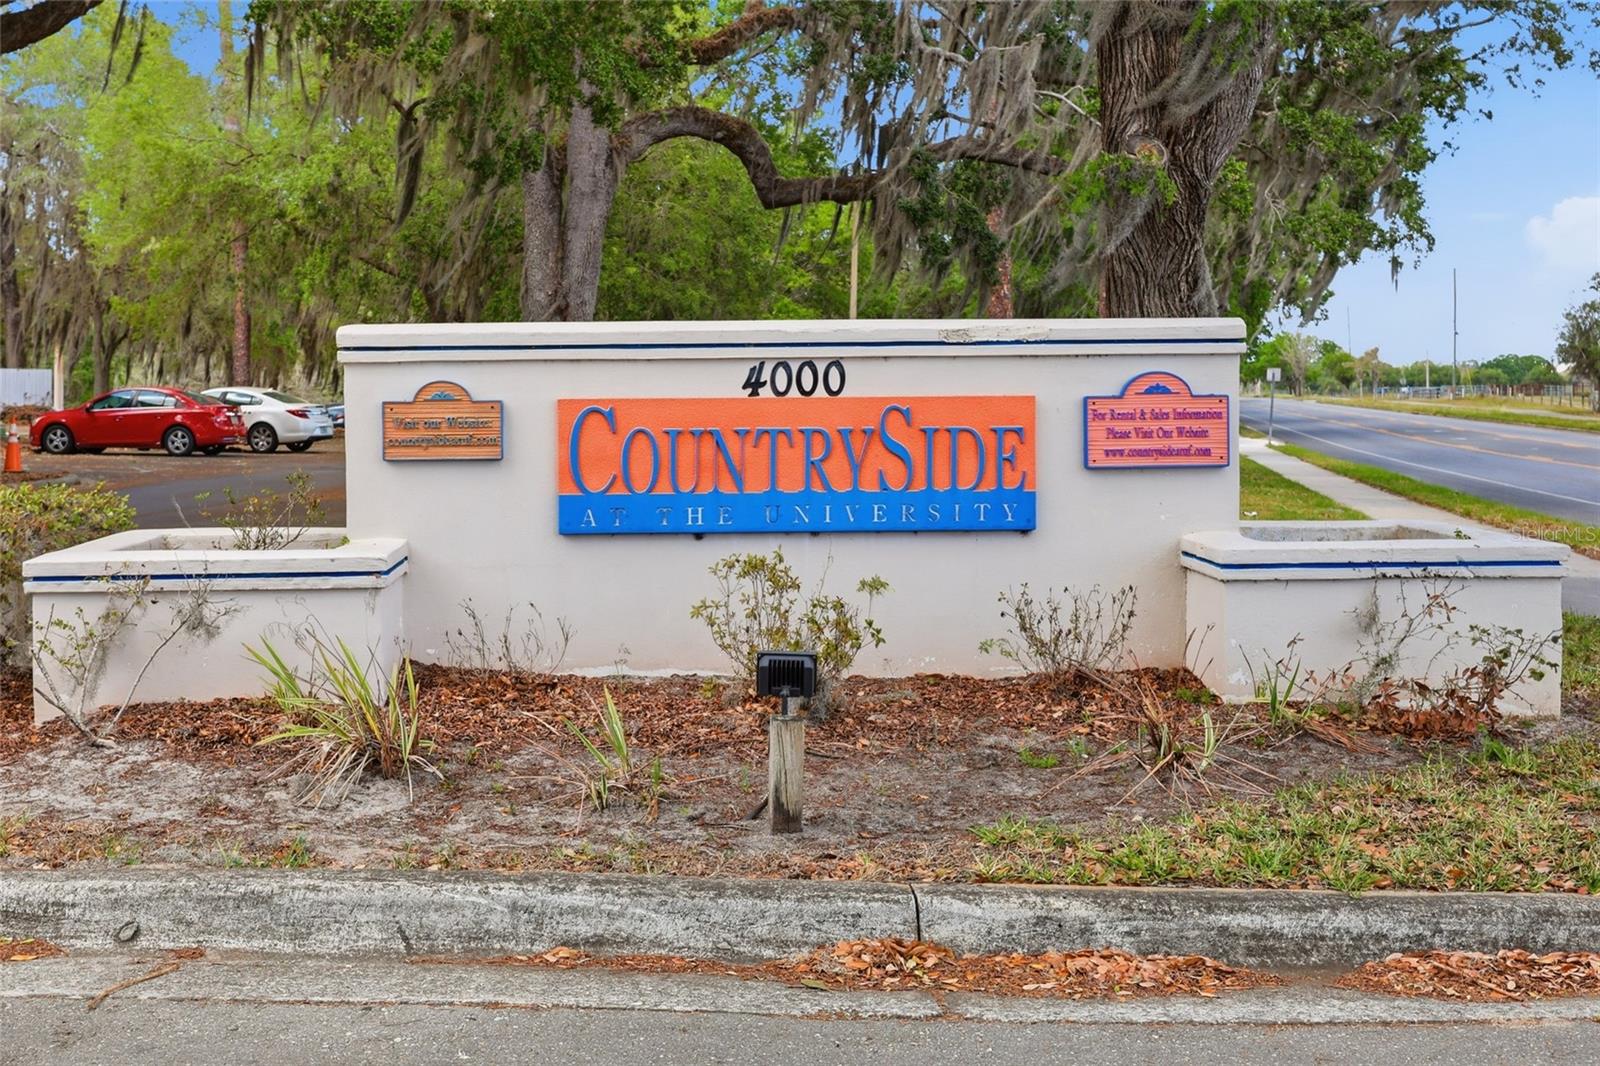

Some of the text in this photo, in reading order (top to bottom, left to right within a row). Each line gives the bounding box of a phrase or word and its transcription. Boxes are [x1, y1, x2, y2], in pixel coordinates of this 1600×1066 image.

[741, 360, 846, 397] 4000
[1091, 408, 1223, 421] For Rental & Sales Information
[1106, 426, 1209, 439] Please Visit Our Website
[581, 504, 1017, 527] AT THE UNIVERSITY
